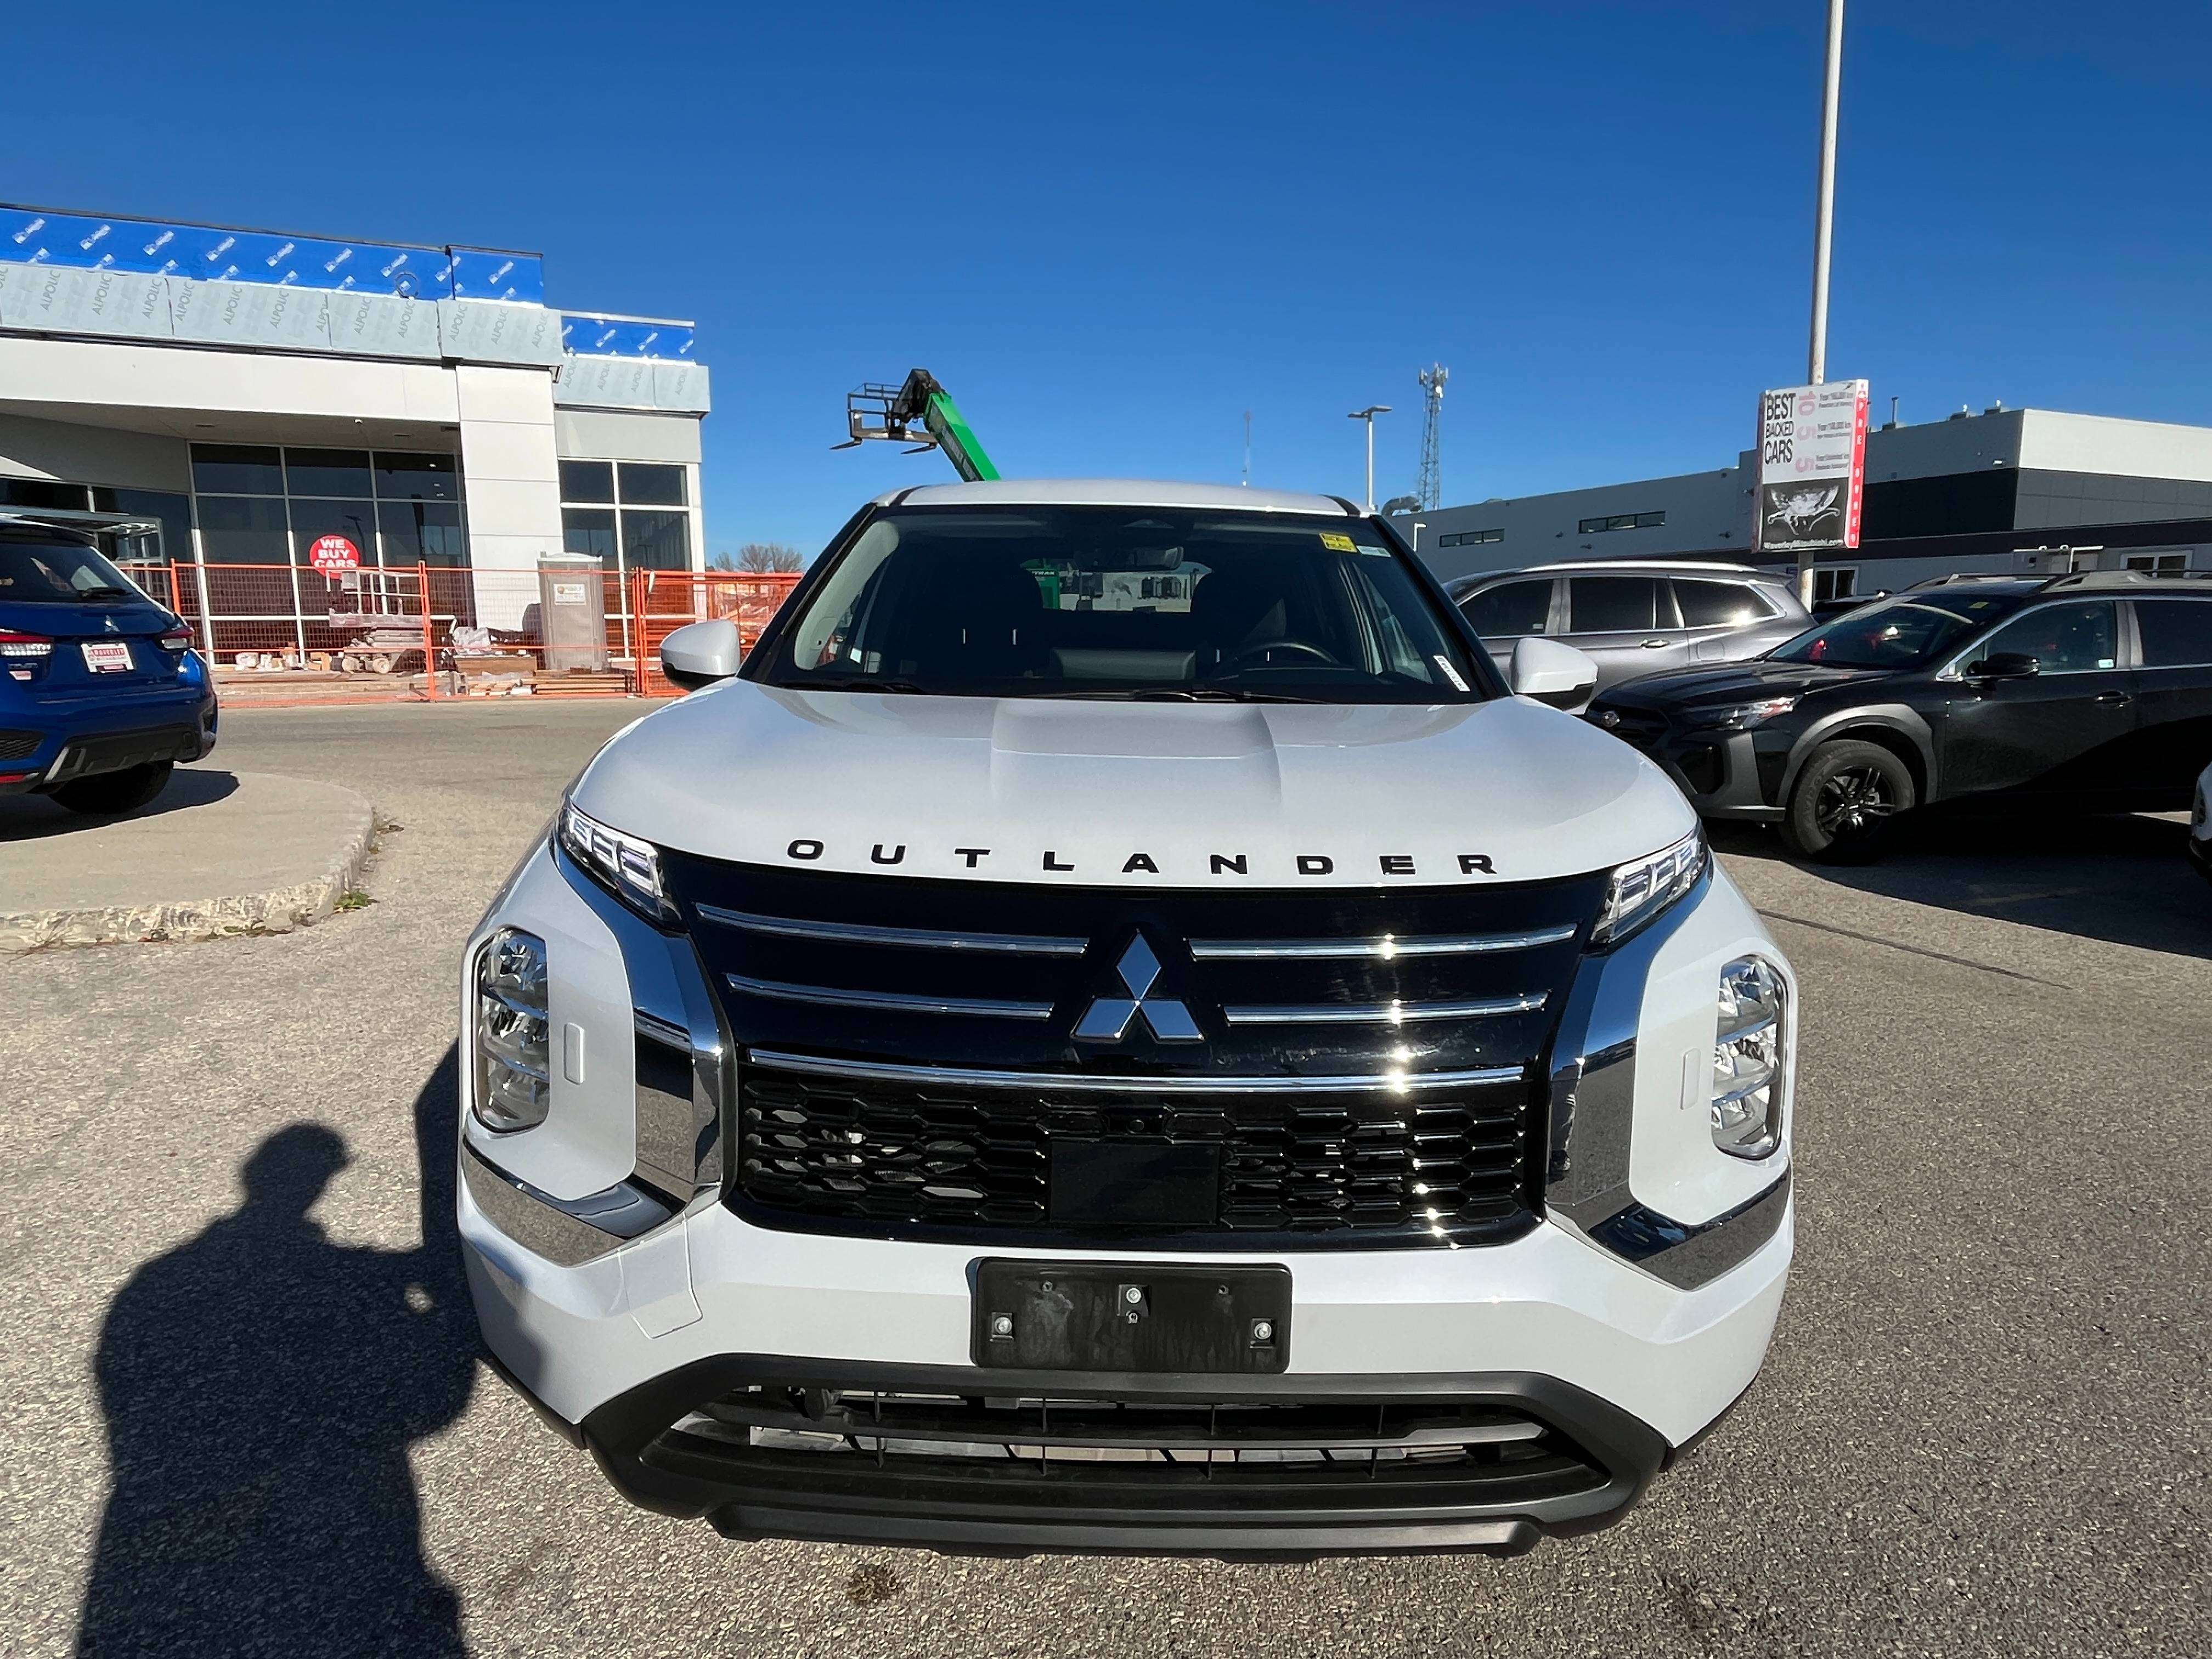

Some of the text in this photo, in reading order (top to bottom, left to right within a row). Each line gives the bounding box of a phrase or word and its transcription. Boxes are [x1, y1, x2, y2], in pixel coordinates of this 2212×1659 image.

[142, 278, 162, 320] ALPOLIC
[175, 280, 195, 321] ALPOLIC
[223, 285, 242, 325] ALPOLIC
[269, 289, 289, 329] ALPOLIC
[1765, 393, 1796, 420] BEST
[1765, 439, 1793, 464] CARS
[318, 549, 350, 558] BUY
[319, 539, 345, 549] WE
[787, 839, 1498, 875] OUTLANDER
